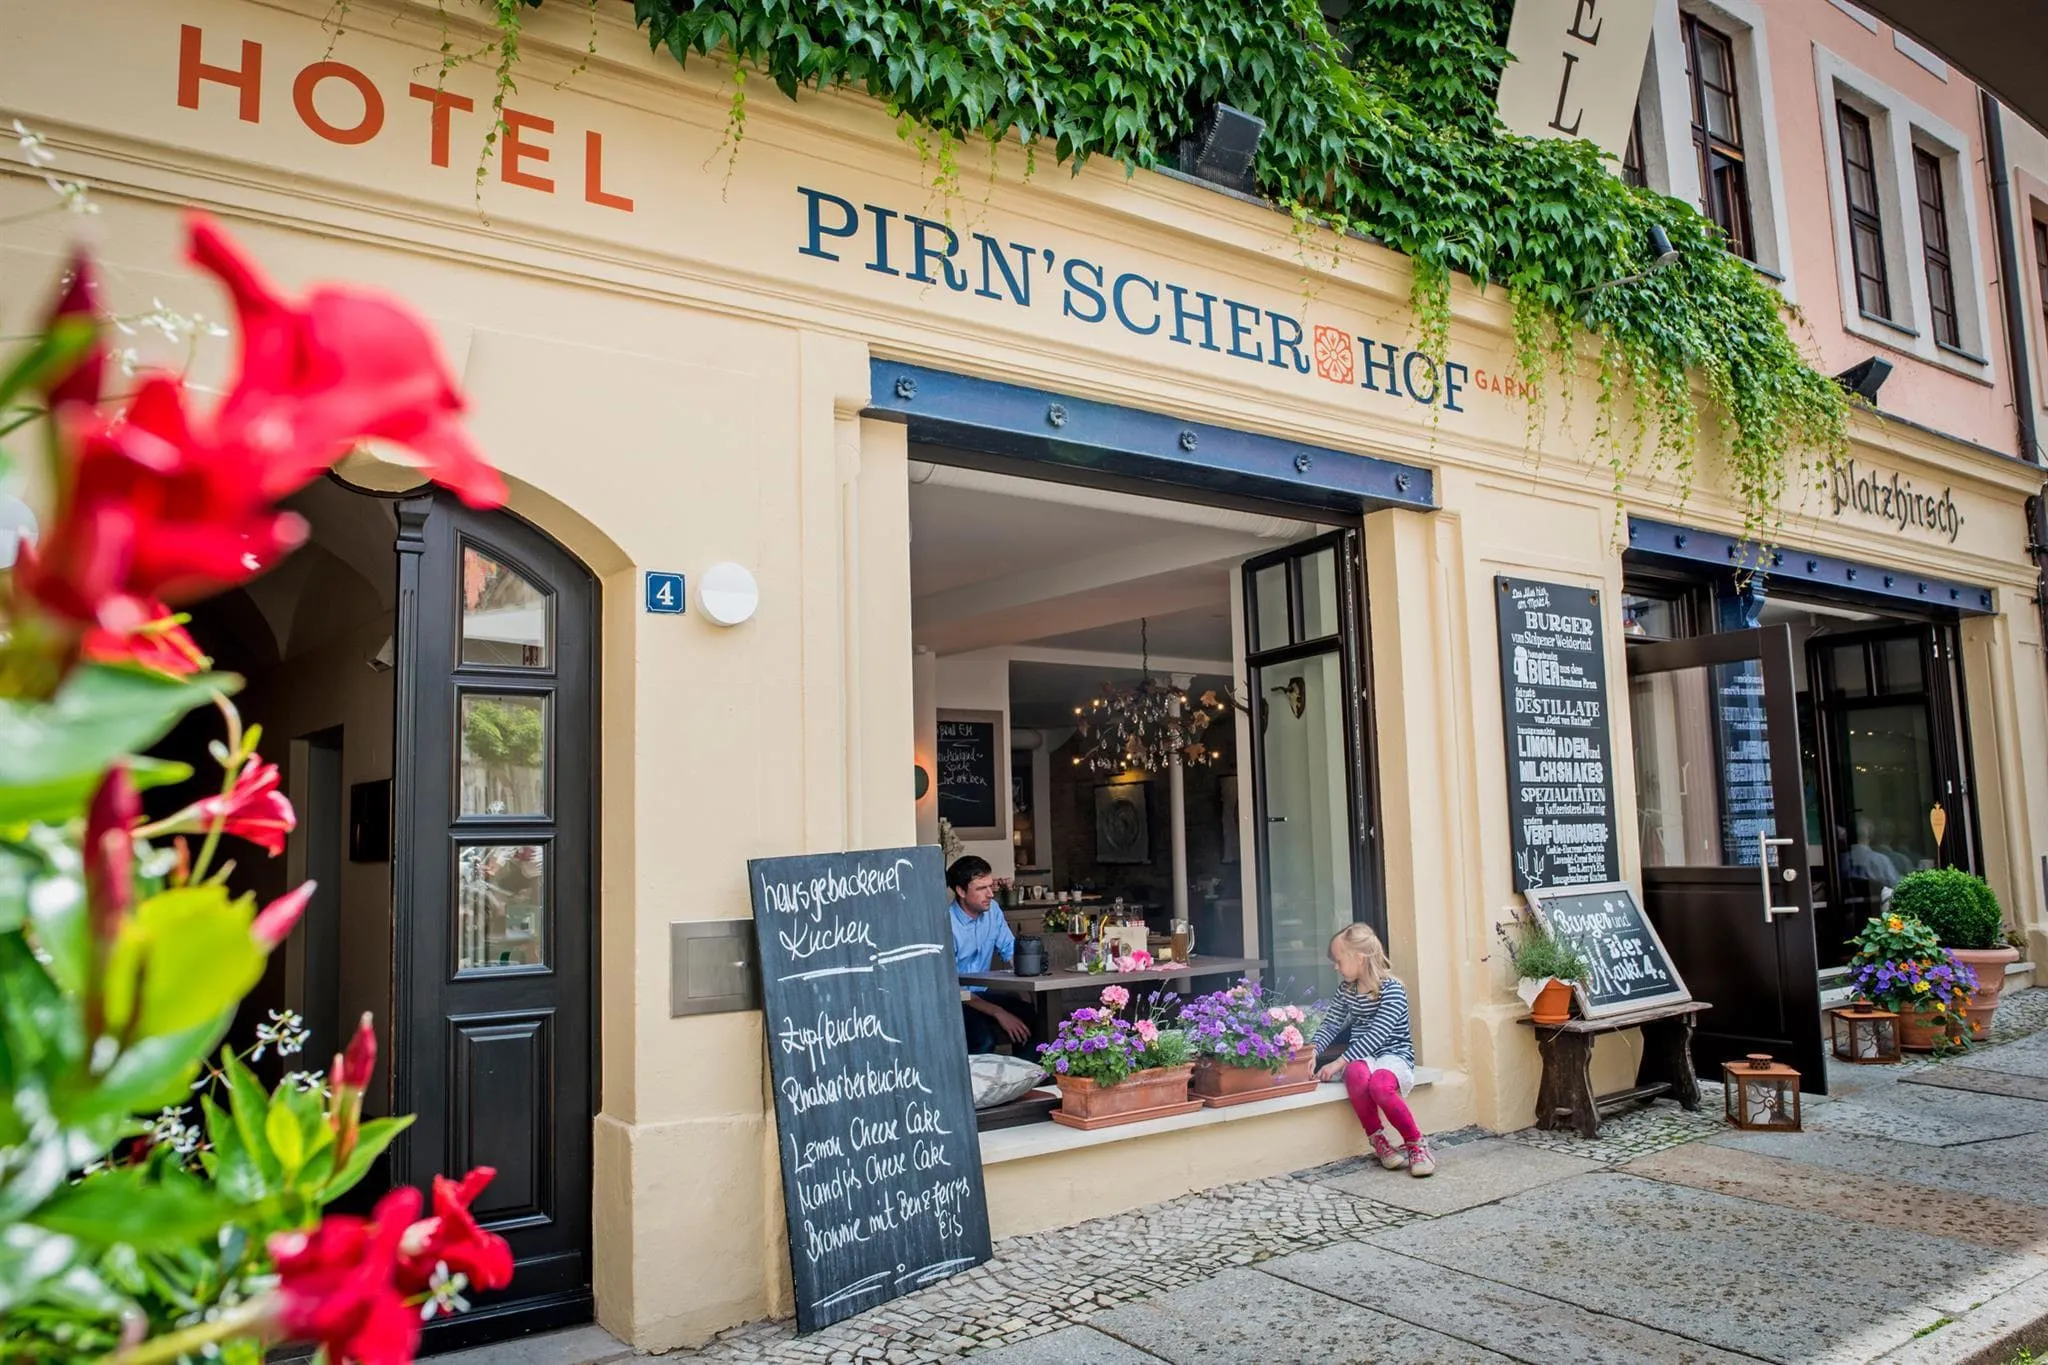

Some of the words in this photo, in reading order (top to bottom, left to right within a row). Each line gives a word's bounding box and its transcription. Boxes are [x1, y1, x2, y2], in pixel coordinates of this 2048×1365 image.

[177, 23, 634, 213] HOTEL
[797, 186, 1310, 376] PIRN'SCHER
[1357, 336, 1469, 414] HOF
[1474, 369, 1537, 404] GARNI
[656, 581, 674, 606] 4
[1525, 611, 1594, 636] BURGER
[1527, 658, 1560, 686] BIER
[1515, 697, 1600, 717] DESTILLATE
[1518, 735, 1589, 759] LIMONADEN
[1519, 760, 1604, 784] MILCHSHAKES
[1521, 784, 1605, 802] SPEZIALITÄTEN
[761, 858, 913, 923] hausgebackener
[778, 914, 877, 960] Kuchen
[1610, 912, 1631, 928] und
[1584, 938, 1645, 995] Markt
[778, 1006, 903, 1072] Zupfkuchen
[782, 1058, 933, 1115] Rhabarberkuchen
[790, 1133, 844, 1174] Lemon
[850, 1116, 900, 1151] Cheese
[906, 1101, 953, 1134] Cake
[866, 1153, 907, 1184] Cheese
[913, 1139, 952, 1171] Cake
[804, 1217, 871, 1262] Brownie
[870, 1191, 898, 1234] mit
[897, 1190, 921, 1220] Ben
[939, 1210, 963, 1239] Eis
